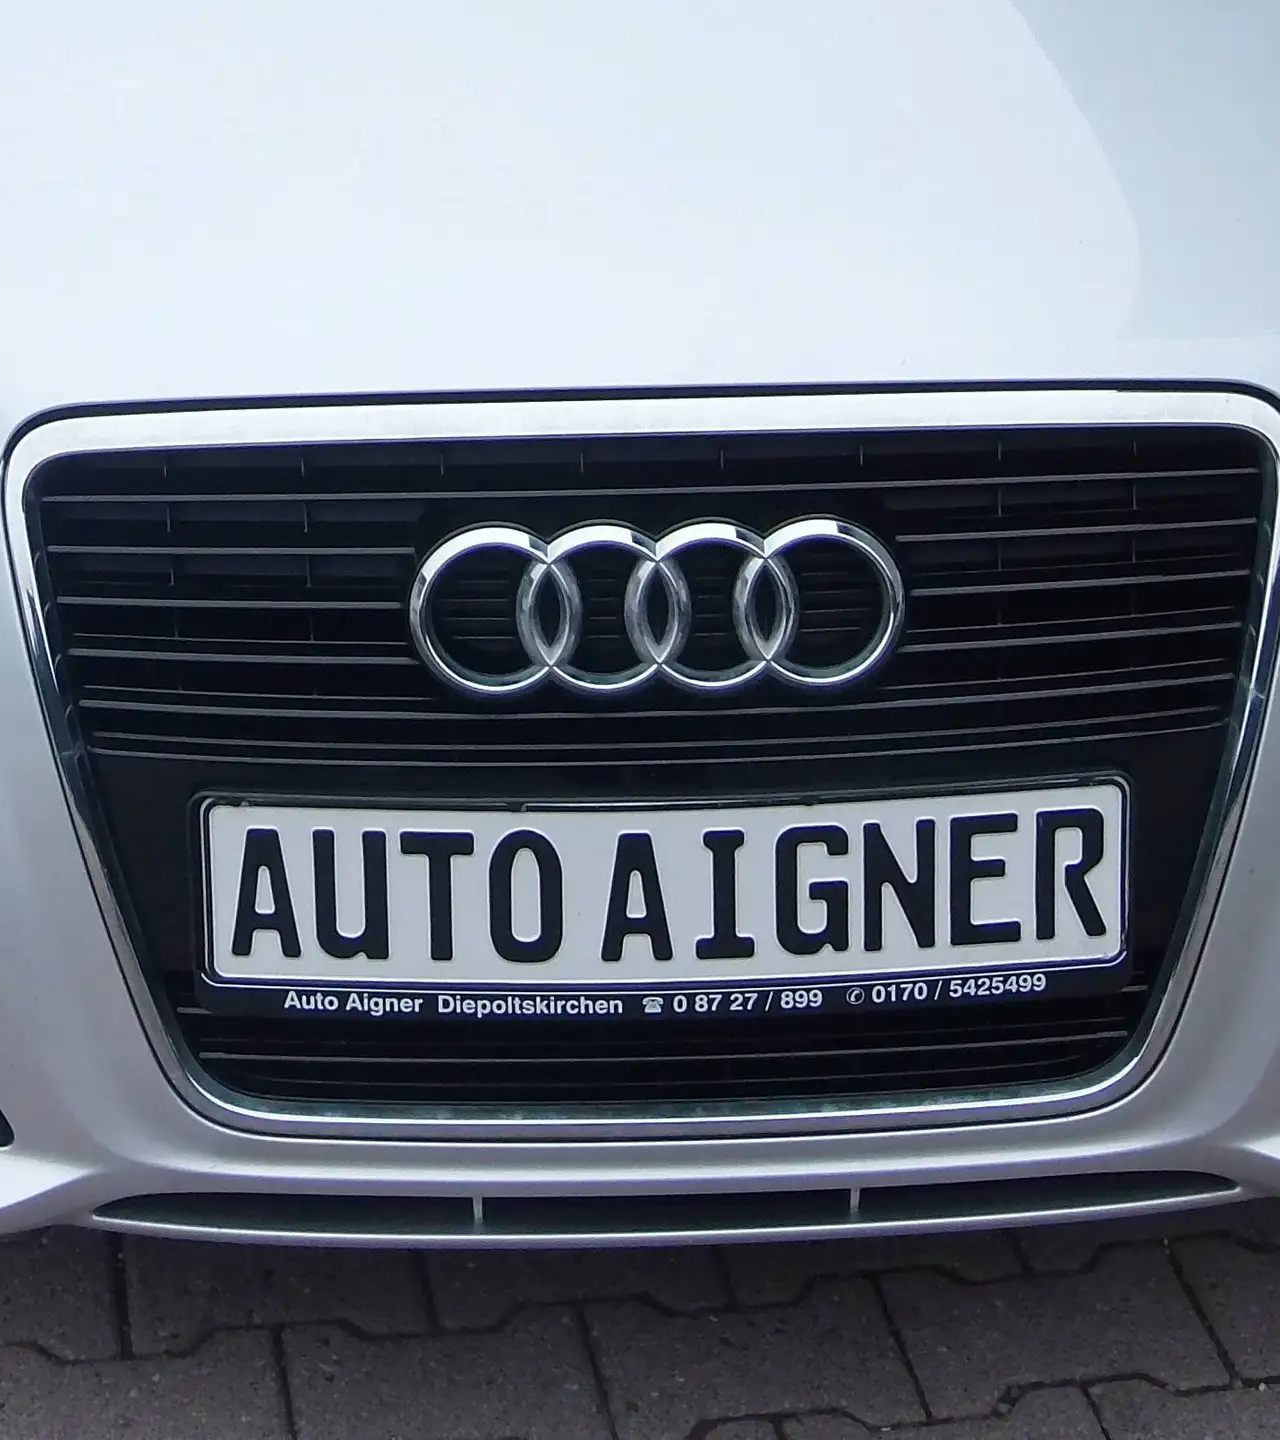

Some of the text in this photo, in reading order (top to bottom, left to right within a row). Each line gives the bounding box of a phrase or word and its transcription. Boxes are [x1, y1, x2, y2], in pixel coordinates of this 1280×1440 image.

[231, 807, 1107, 963] AUTO AIGNER
[284, 990, 339, 1011] Auto
[345, 992, 423, 1016] Aigner
[437, 994, 623, 1018] Diepoltskirchen
[780, 989, 823, 1010] 899
[872, 982, 928, 1005] 0170
[949, 973, 1047, 997] 5425499
